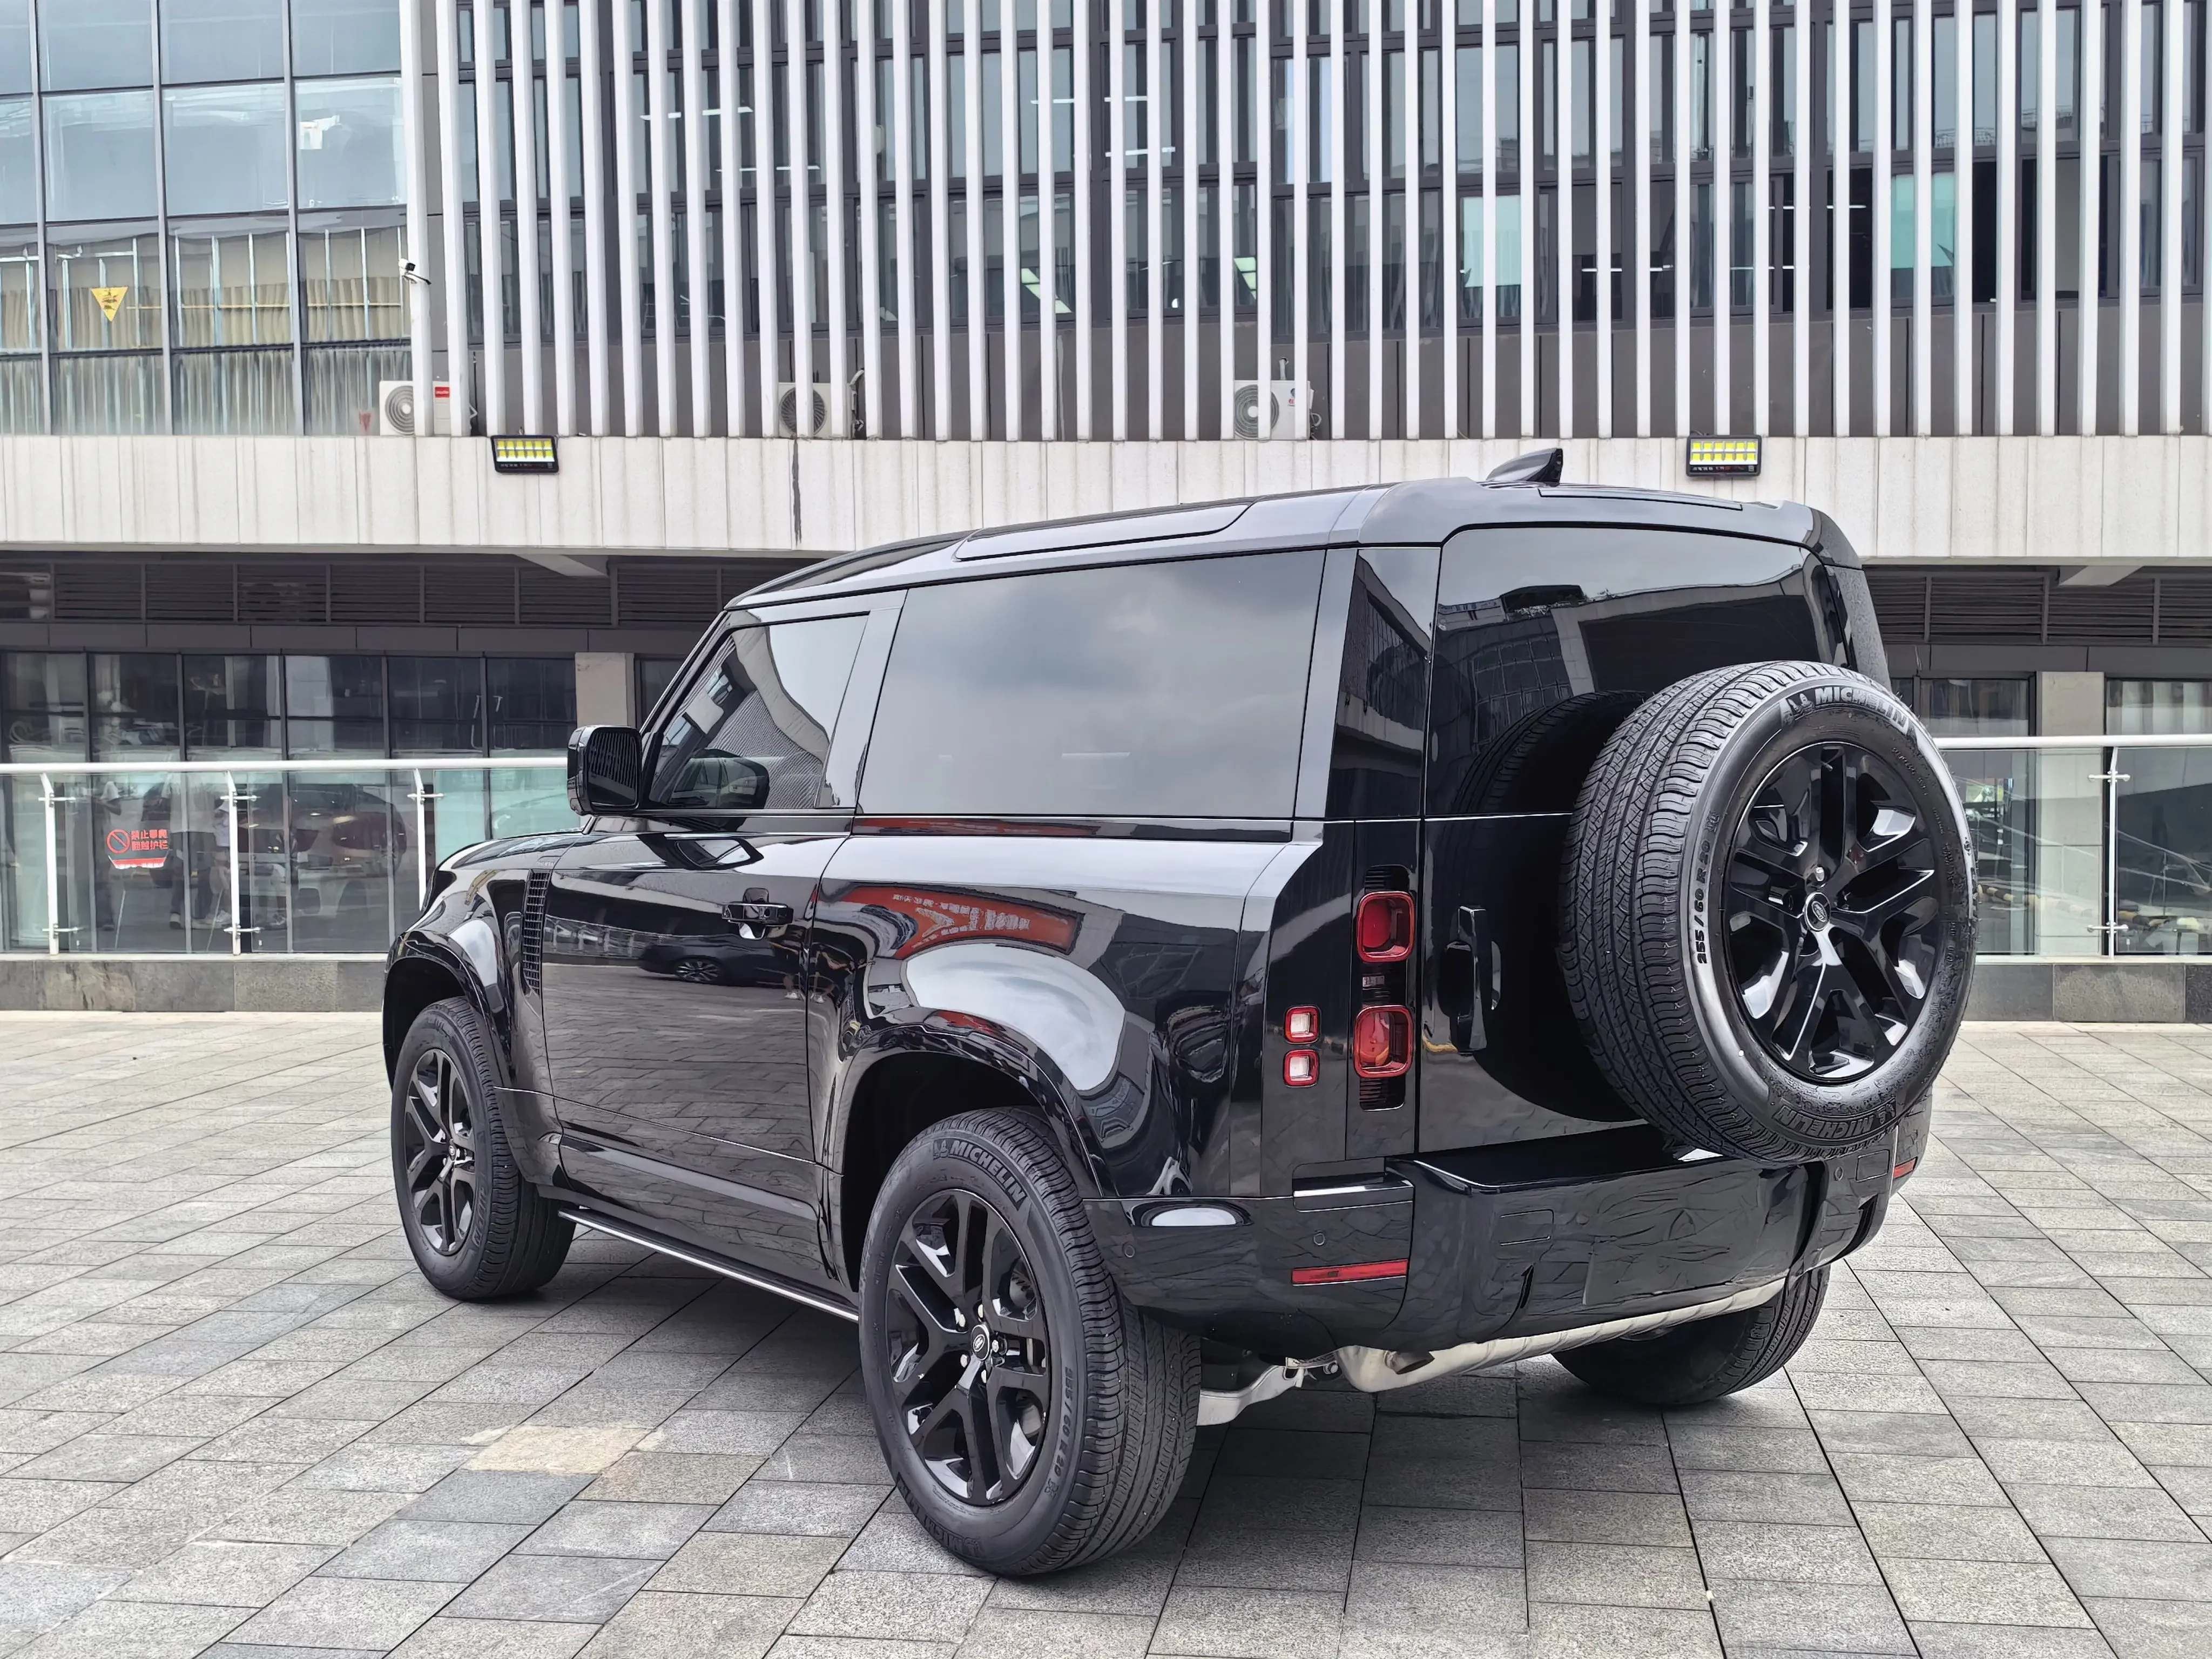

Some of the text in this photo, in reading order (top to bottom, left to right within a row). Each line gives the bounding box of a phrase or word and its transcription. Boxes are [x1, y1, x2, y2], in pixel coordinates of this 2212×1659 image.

[1815, 686, 1909, 736] MICHELIN
[1772, 1105, 1874, 1139] MICHELIN
[950, 1139, 1027, 1203] MICHELIN
